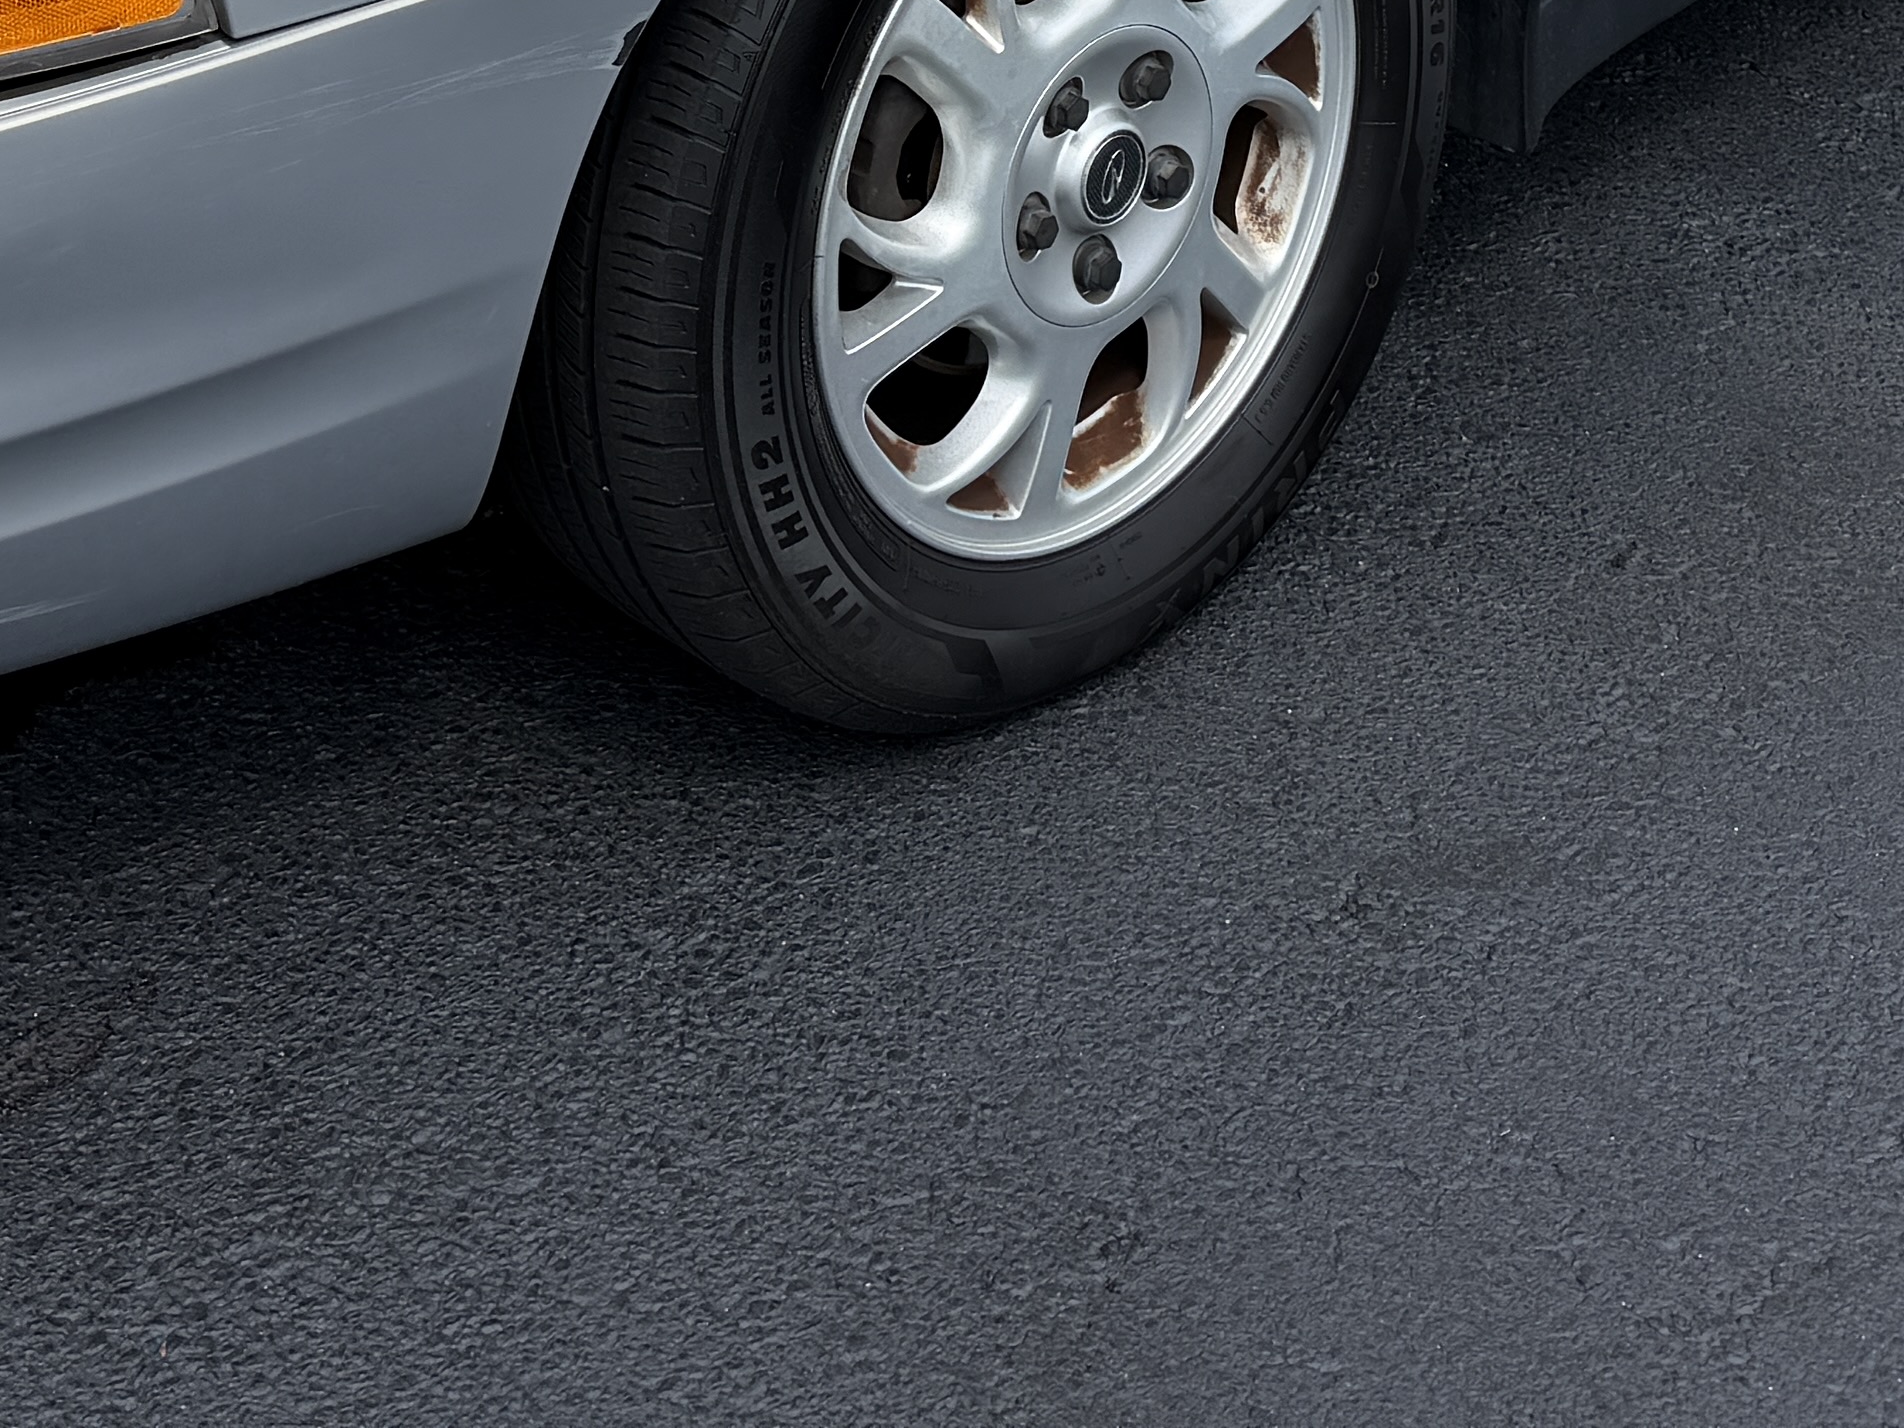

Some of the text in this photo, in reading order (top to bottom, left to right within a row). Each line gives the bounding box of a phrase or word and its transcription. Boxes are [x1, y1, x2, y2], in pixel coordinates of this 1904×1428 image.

[757, 260, 779, 366] SEASON
[756, 369, 778, 417] ALL
[750, 435, 811, 551] HH2
